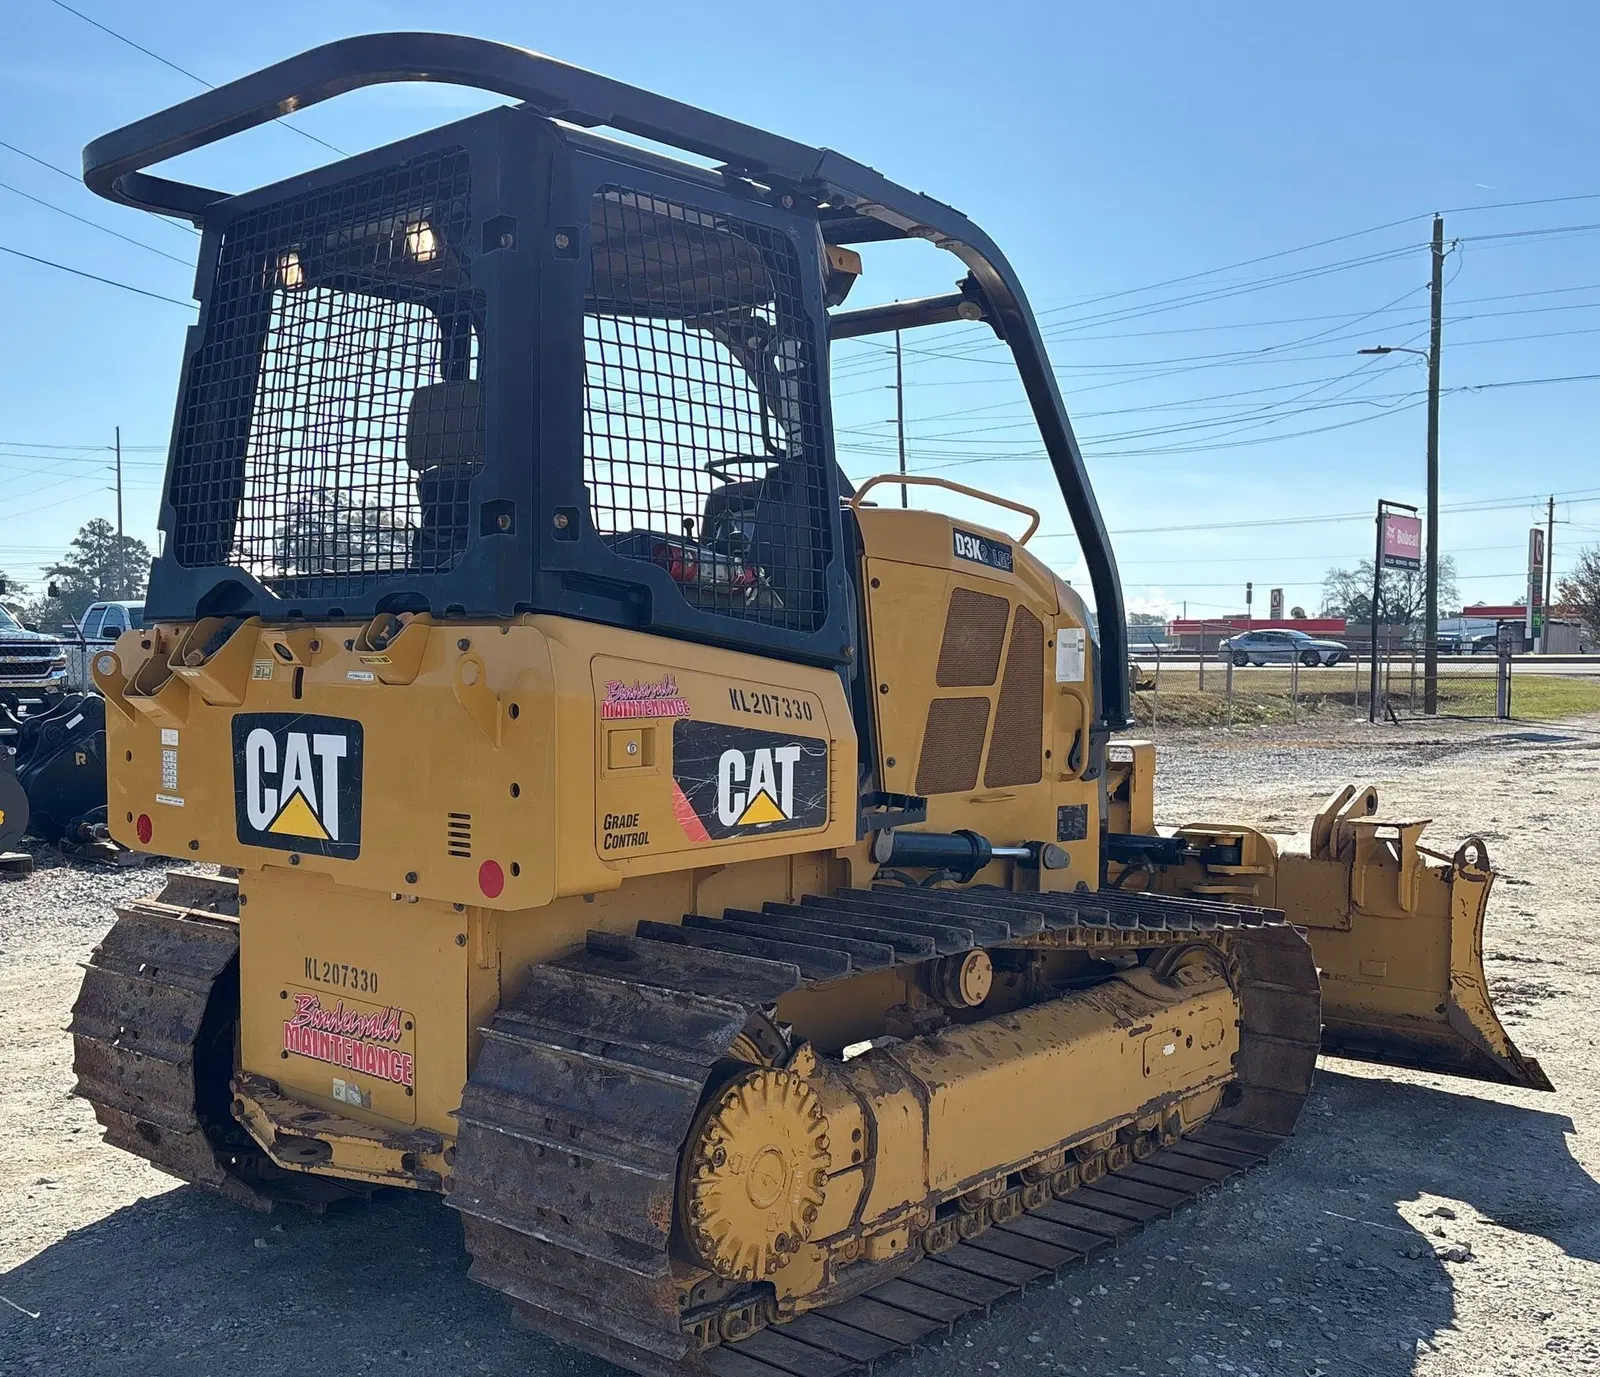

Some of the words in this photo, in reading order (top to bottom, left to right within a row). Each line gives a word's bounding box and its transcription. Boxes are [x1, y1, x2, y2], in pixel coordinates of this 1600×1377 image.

[601, 697, 691, 720] MAINTENANCE
[729, 688, 813, 721] KL207330
[246, 727, 347, 841] CAT
[718, 746, 800, 827] CAT
[604, 813, 640, 830] GRADE
[604, 831, 649, 850] CONTROL
[305, 956, 378, 994] KL207330
[291, 993, 404, 1044] Bindewald
[283, 1019, 413, 1087] MAINTENANCE
